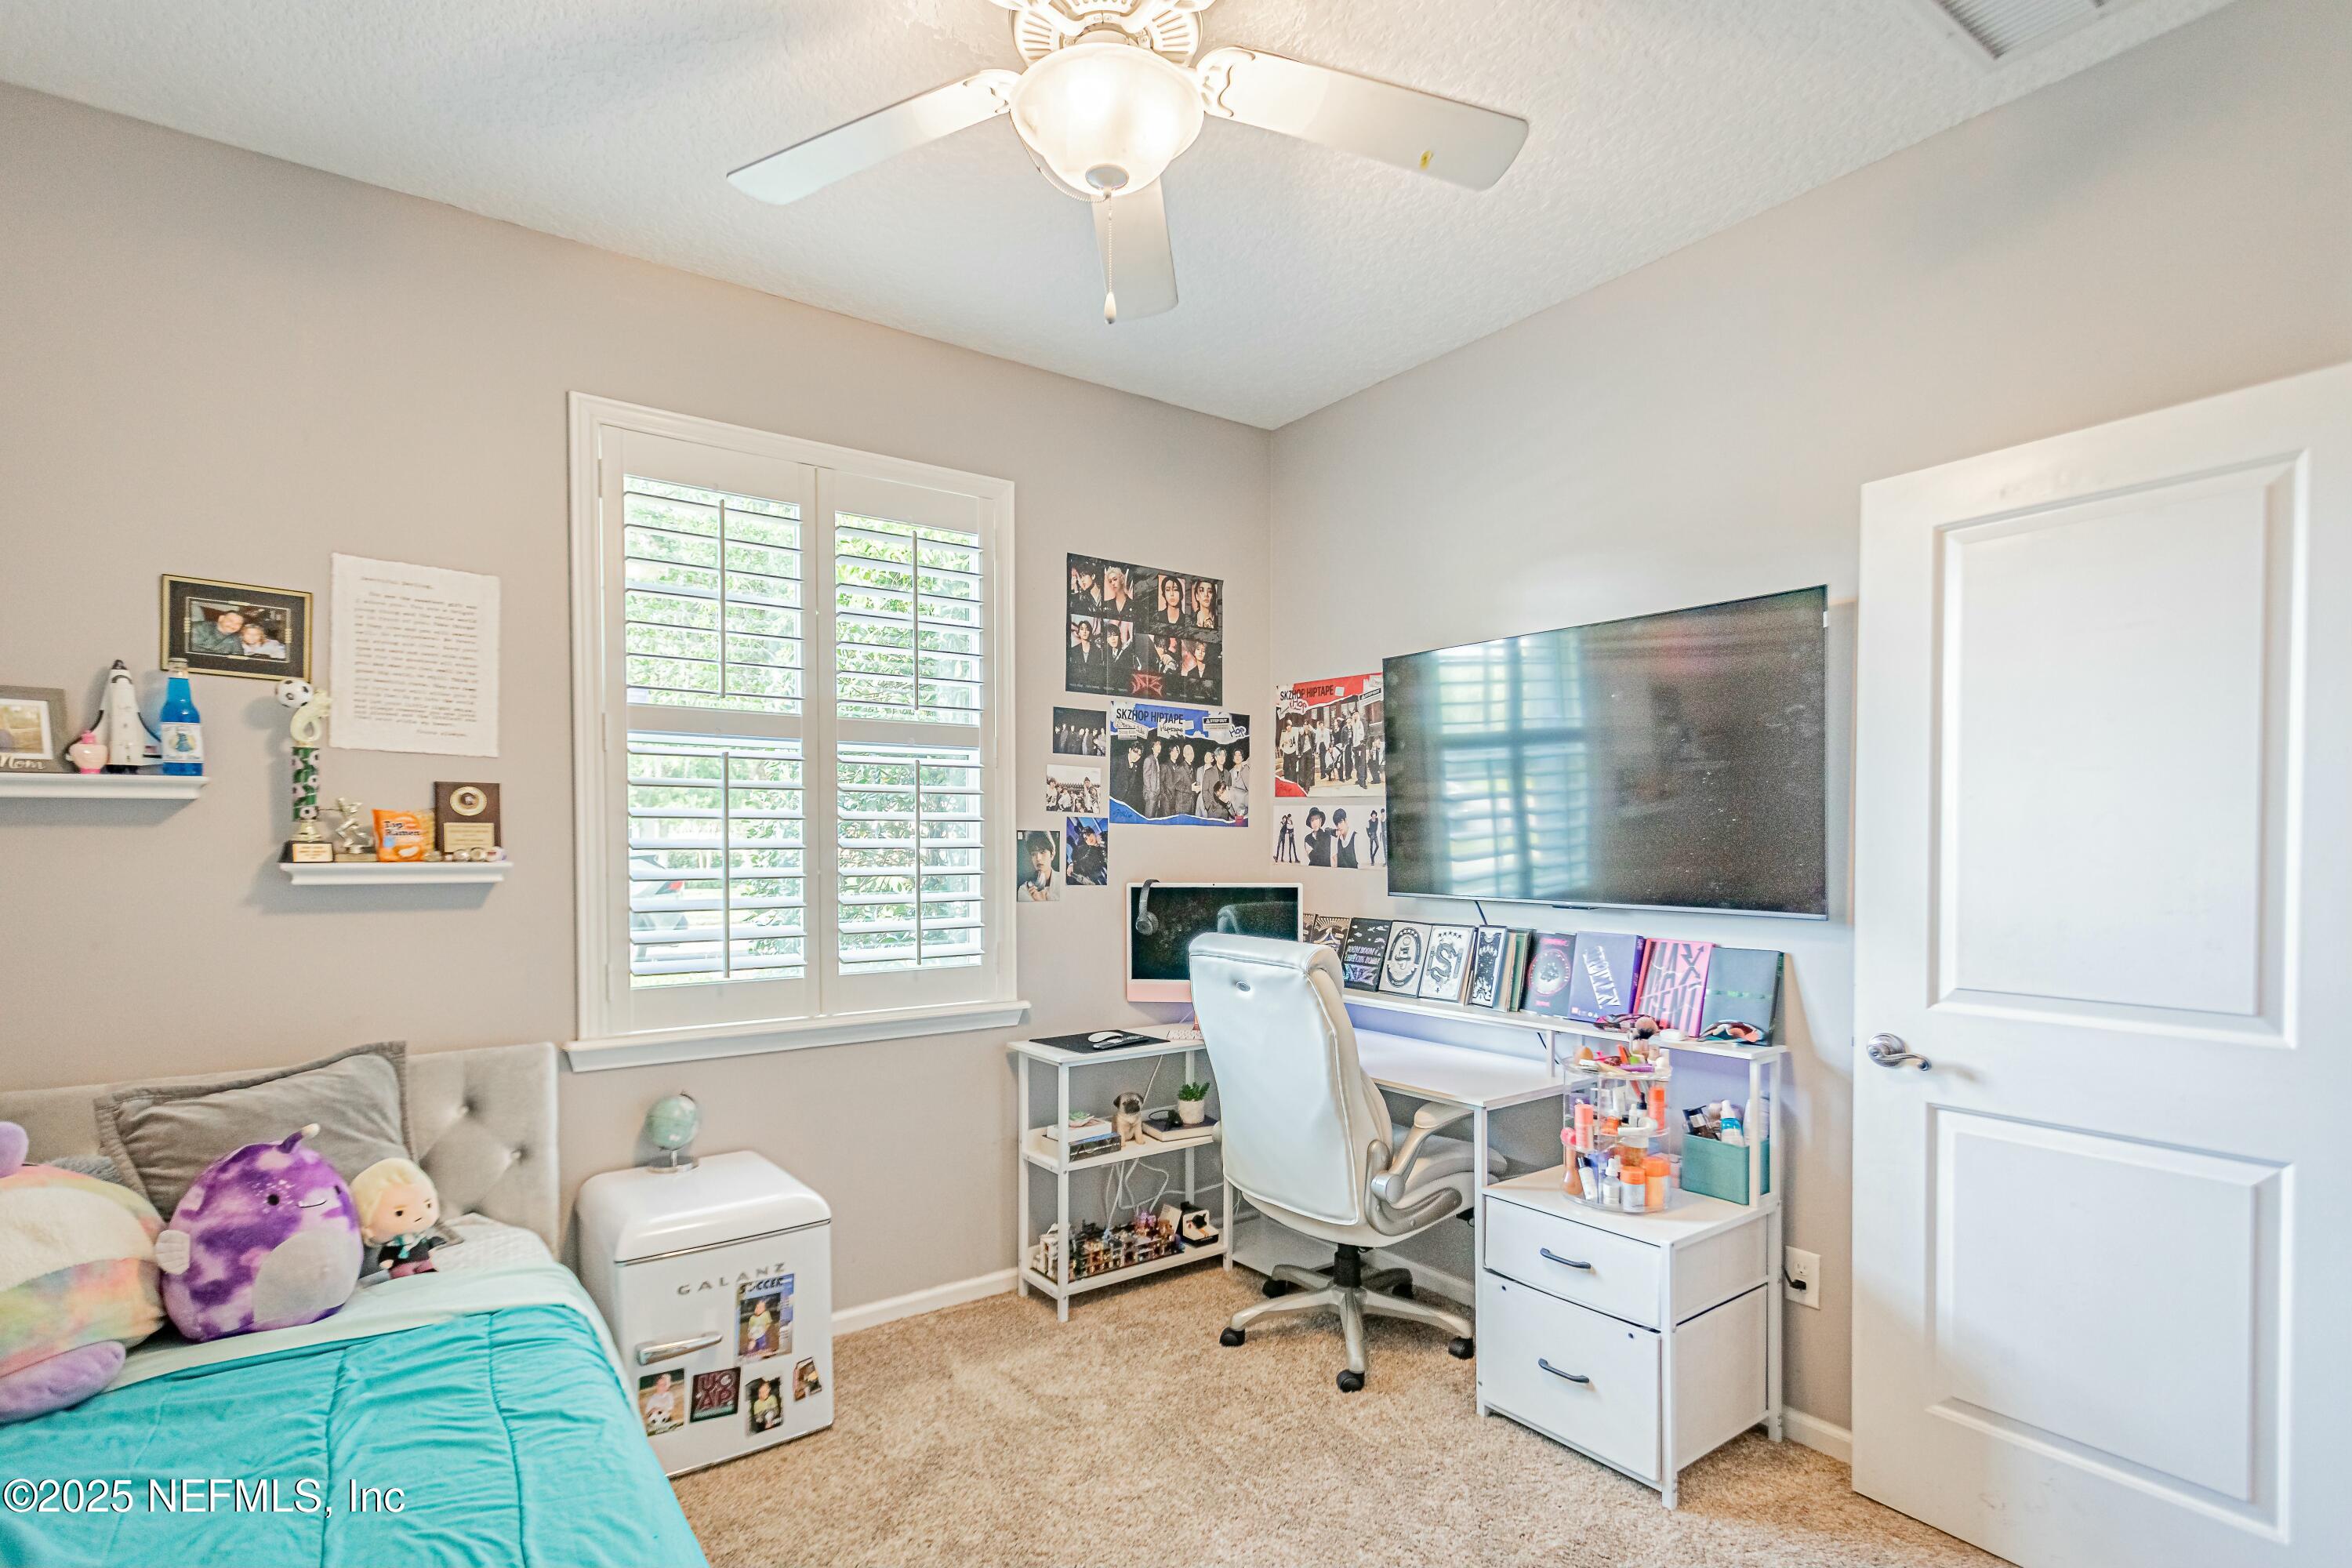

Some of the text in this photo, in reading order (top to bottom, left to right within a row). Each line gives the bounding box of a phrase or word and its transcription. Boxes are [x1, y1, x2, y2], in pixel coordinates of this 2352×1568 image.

[1280, 685, 1334, 701] SKZHOP HIPTAPE
[1116, 708, 1184, 724] SKZHOP HIPTAPE
[1229, 725, 1245, 738] Hop
[677, 1262, 785, 1295] GALANZ
